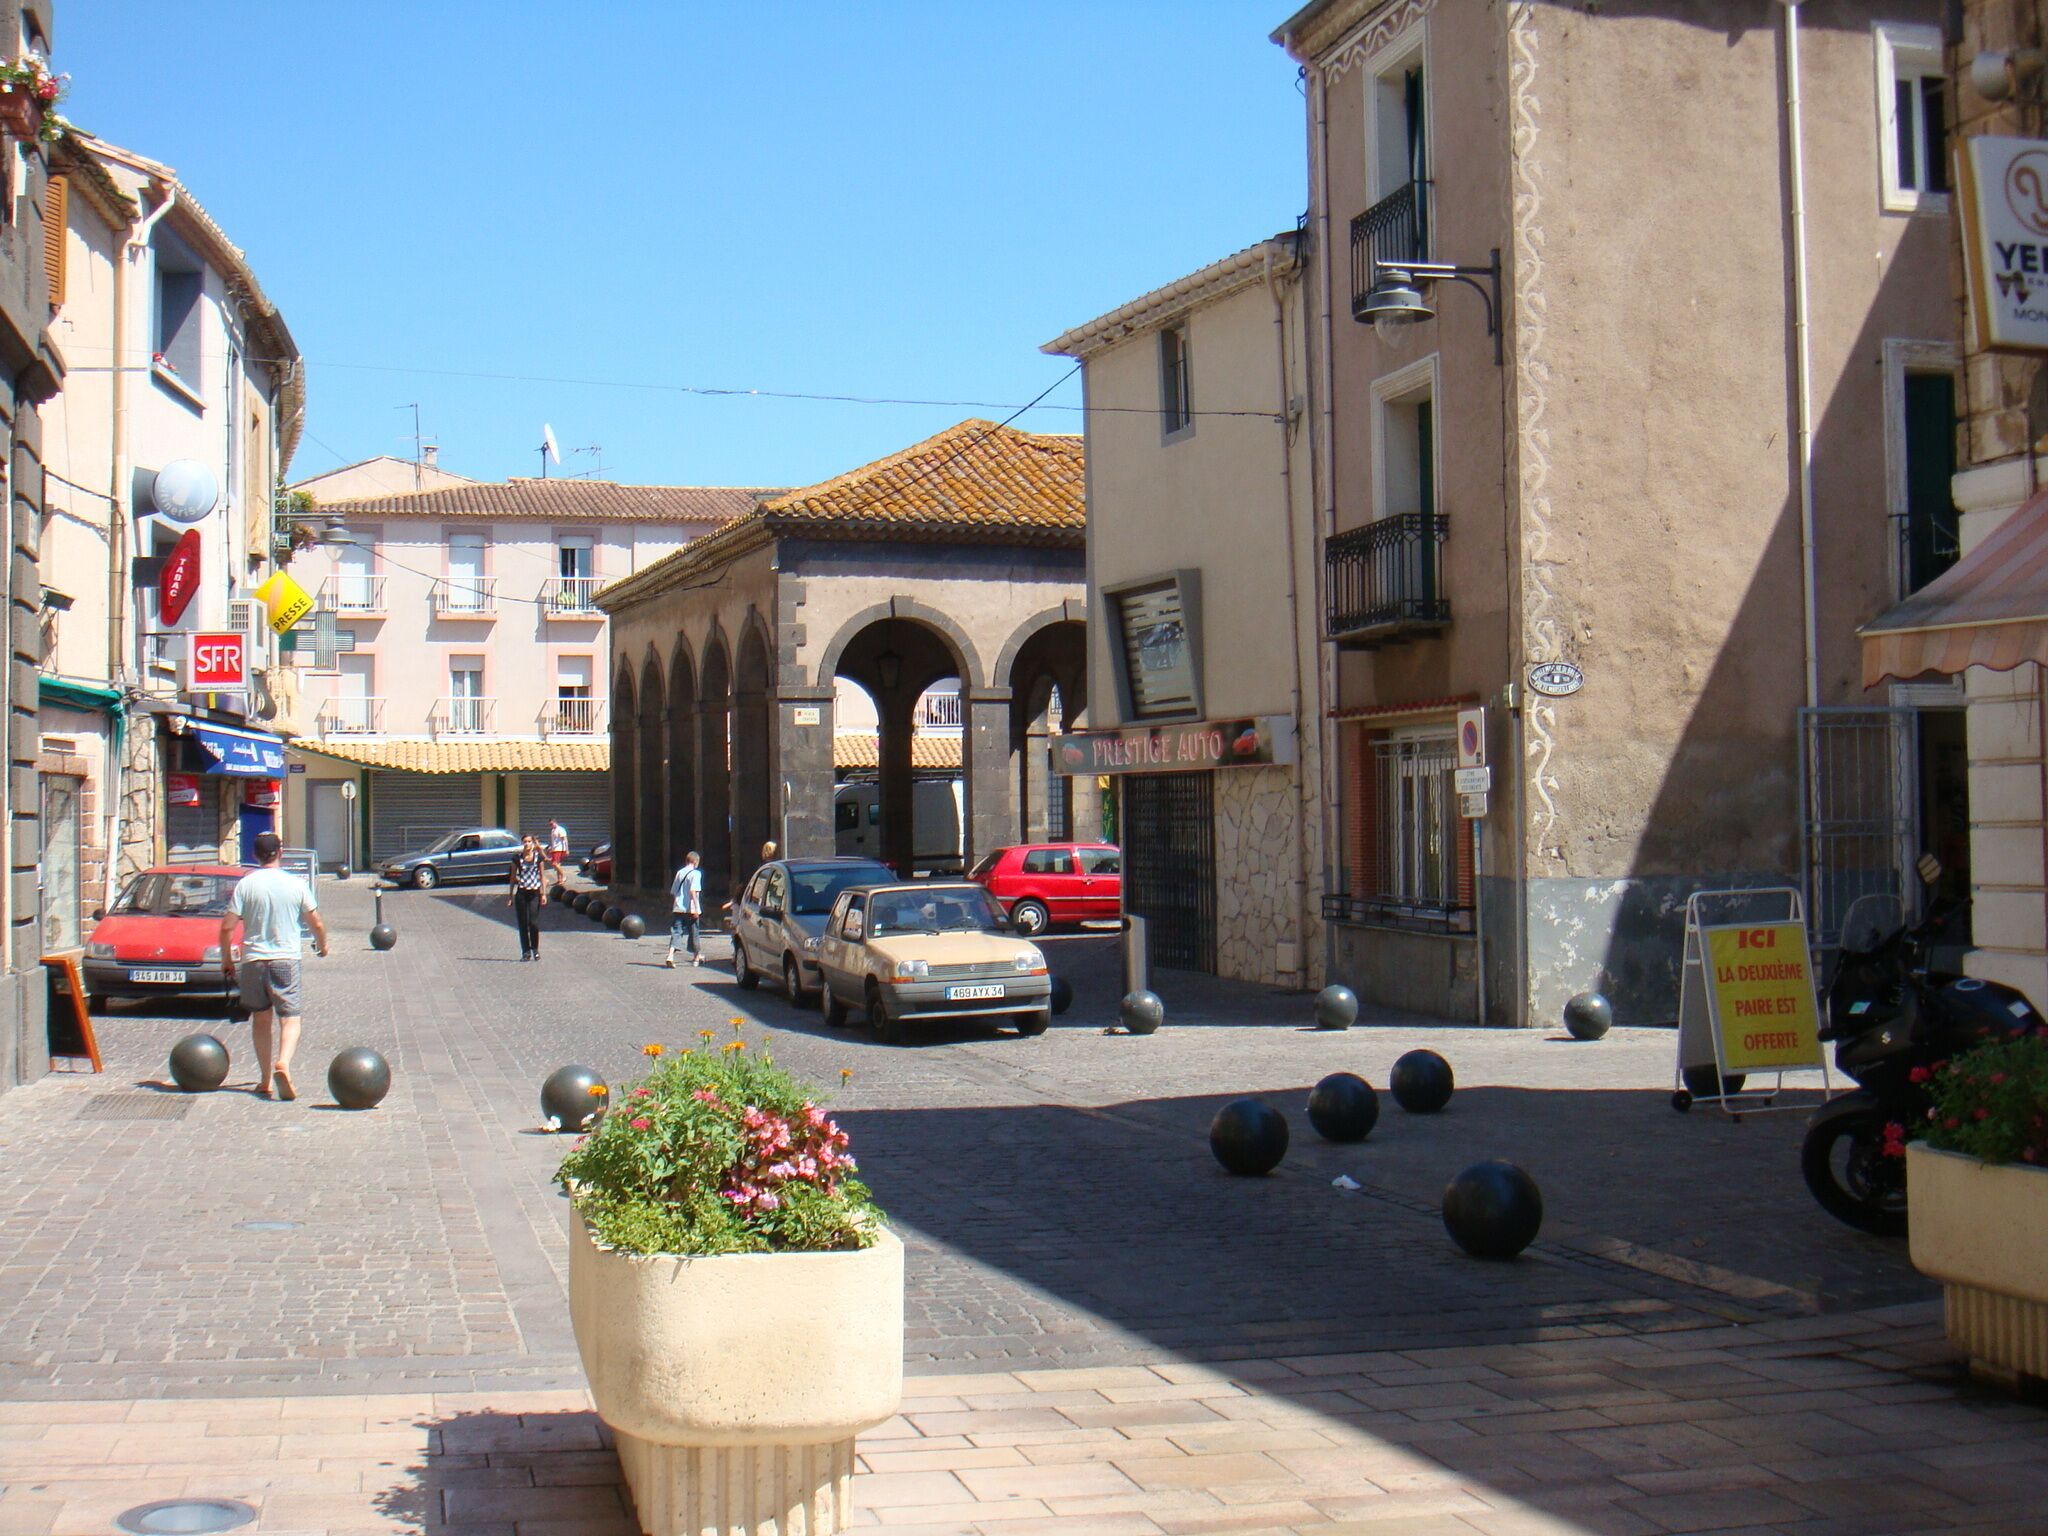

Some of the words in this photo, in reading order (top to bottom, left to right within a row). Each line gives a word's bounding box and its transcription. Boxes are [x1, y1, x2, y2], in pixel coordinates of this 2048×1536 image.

[170, 558, 187, 597] TABAC
[273, 598, 307, 631] PRESSE
[196, 645, 240, 673] SFR
[1092, 734, 1171, 767] PRESTIGE
[1177, 730, 1223, 761] AUTO
[1738, 929, 1776, 949] ICI
[1718, 966, 1735, 983] LA
[1738, 960, 1803, 982] DEUXIÈME
[953, 988, 971, 998] 469
[973, 987, 990, 997] AYX
[991, 986, 1003, 997] 34
[1735, 998, 1773, 1017] PAIRE
[1776, 998, 1797, 1015] EST
[1744, 1032, 1799, 1051] OFFERTE
